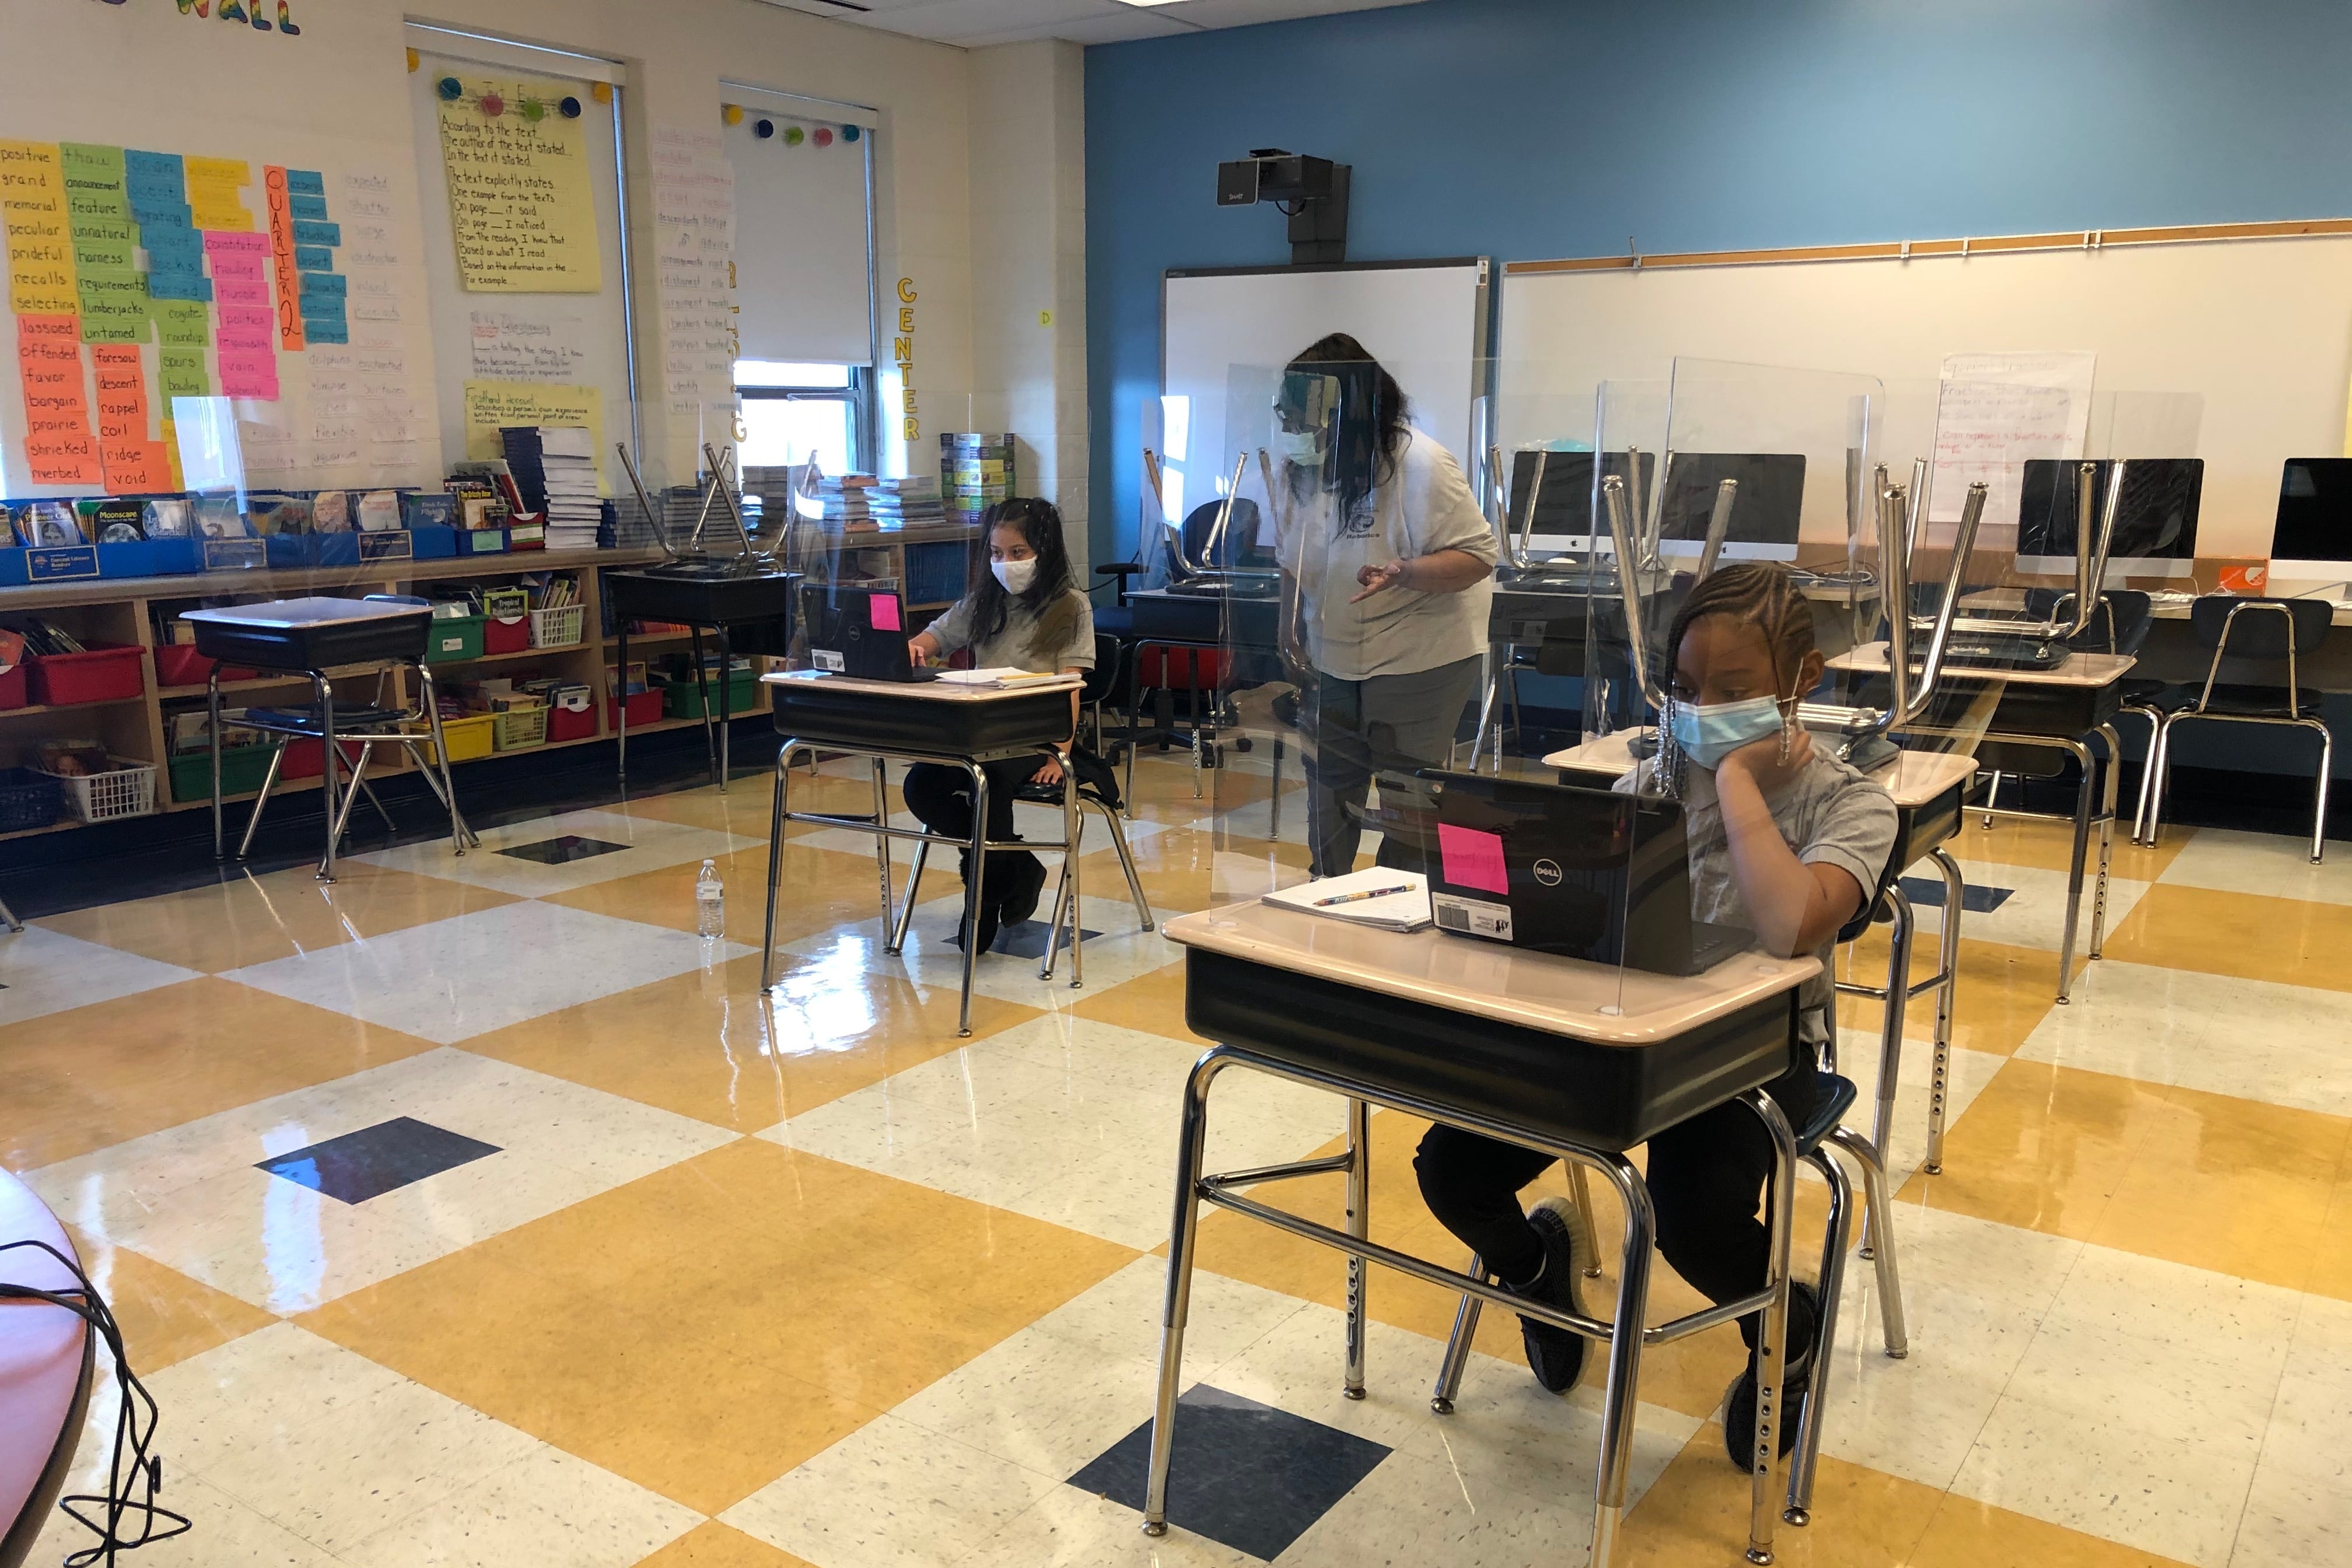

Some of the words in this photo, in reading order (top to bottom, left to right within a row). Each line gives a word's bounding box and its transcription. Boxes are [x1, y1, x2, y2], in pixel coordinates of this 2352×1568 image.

[442, 114, 480, 137] According
[484, 119, 494, 134] to
[496, 120, 510, 136] the
[443, 131, 457, 146] The
[460, 136, 485, 149] author
[488, 136, 495, 148] of
[498, 138, 512, 151] the
[516, 139, 532, 152] text
[1, 148, 50, 163] positive
[447, 146, 456, 160] In
[458, 148, 469, 161] the
[473, 149, 488, 162] text
[492, 151, 498, 163] it
[2, 173, 46, 186] grand
[449, 166, 461, 182] The
[463, 168, 482, 184] text
[485, 173, 522, 188] explicitly
[453, 184, 467, 198] One
[471, 190, 496, 202] example
[501, 191, 516, 201] from
[518, 192, 528, 202] the
[4, 198, 57, 211] memorial
[71, 198, 118, 214] feature
[454, 199, 466, 211] On
[470, 204, 487, 216] page
[506, 205, 513, 214] it
[519, 205, 537, 215] said
[9, 222, 60, 236] peculiar
[456, 214, 468, 225] On
[473, 220, 488, 230] page
[506, 220, 512, 229] I
[73, 225, 130, 239] unnatural
[267, 170, 290, 296] QUARTER
[476, 231, 489, 242] the
[522, 234, 528, 243] I
[12, 247, 62, 261] prideful
[78, 247, 123, 263] harness
[459, 242, 484, 256] Based
[496, 246, 514, 256] what
[519, 248, 525, 257] I
[527, 249, 545, 258] read
[461, 256, 484, 270] Based
[495, 261, 506, 271] the
[509, 262, 544, 271] information
[15, 272, 68, 285] recalls
[79, 278, 145, 291] requirements
[17, 296, 76, 314] selecting
[83, 299, 144, 316] lumberjacks
[169, 306, 202, 322] coyote
[1042, 312, 1050, 324] D
[23, 319, 73, 335] lassoed
[85, 327, 135, 339] untamed
[167, 330, 204, 344] roundup
[20, 343, 77, 360] offended
[96, 348, 137, 363] foresaw
[894, 278, 920, 441] CENTER
[26, 368, 65, 383] favor
[100, 376, 138, 390] descent
[29, 393, 77, 410] bargain
[101, 400, 138, 415] rappel
[32, 419, 78, 435] prairie
[101, 424, 127, 436] coil
[30, 441, 88, 456] shrieked
[107, 449, 142, 463] ridge
[32, 465, 80, 479] riverbed
[113, 471, 146, 484] void
[99, 510, 138, 520] Moonscape
[1536, 867, 1559, 878] DELL
